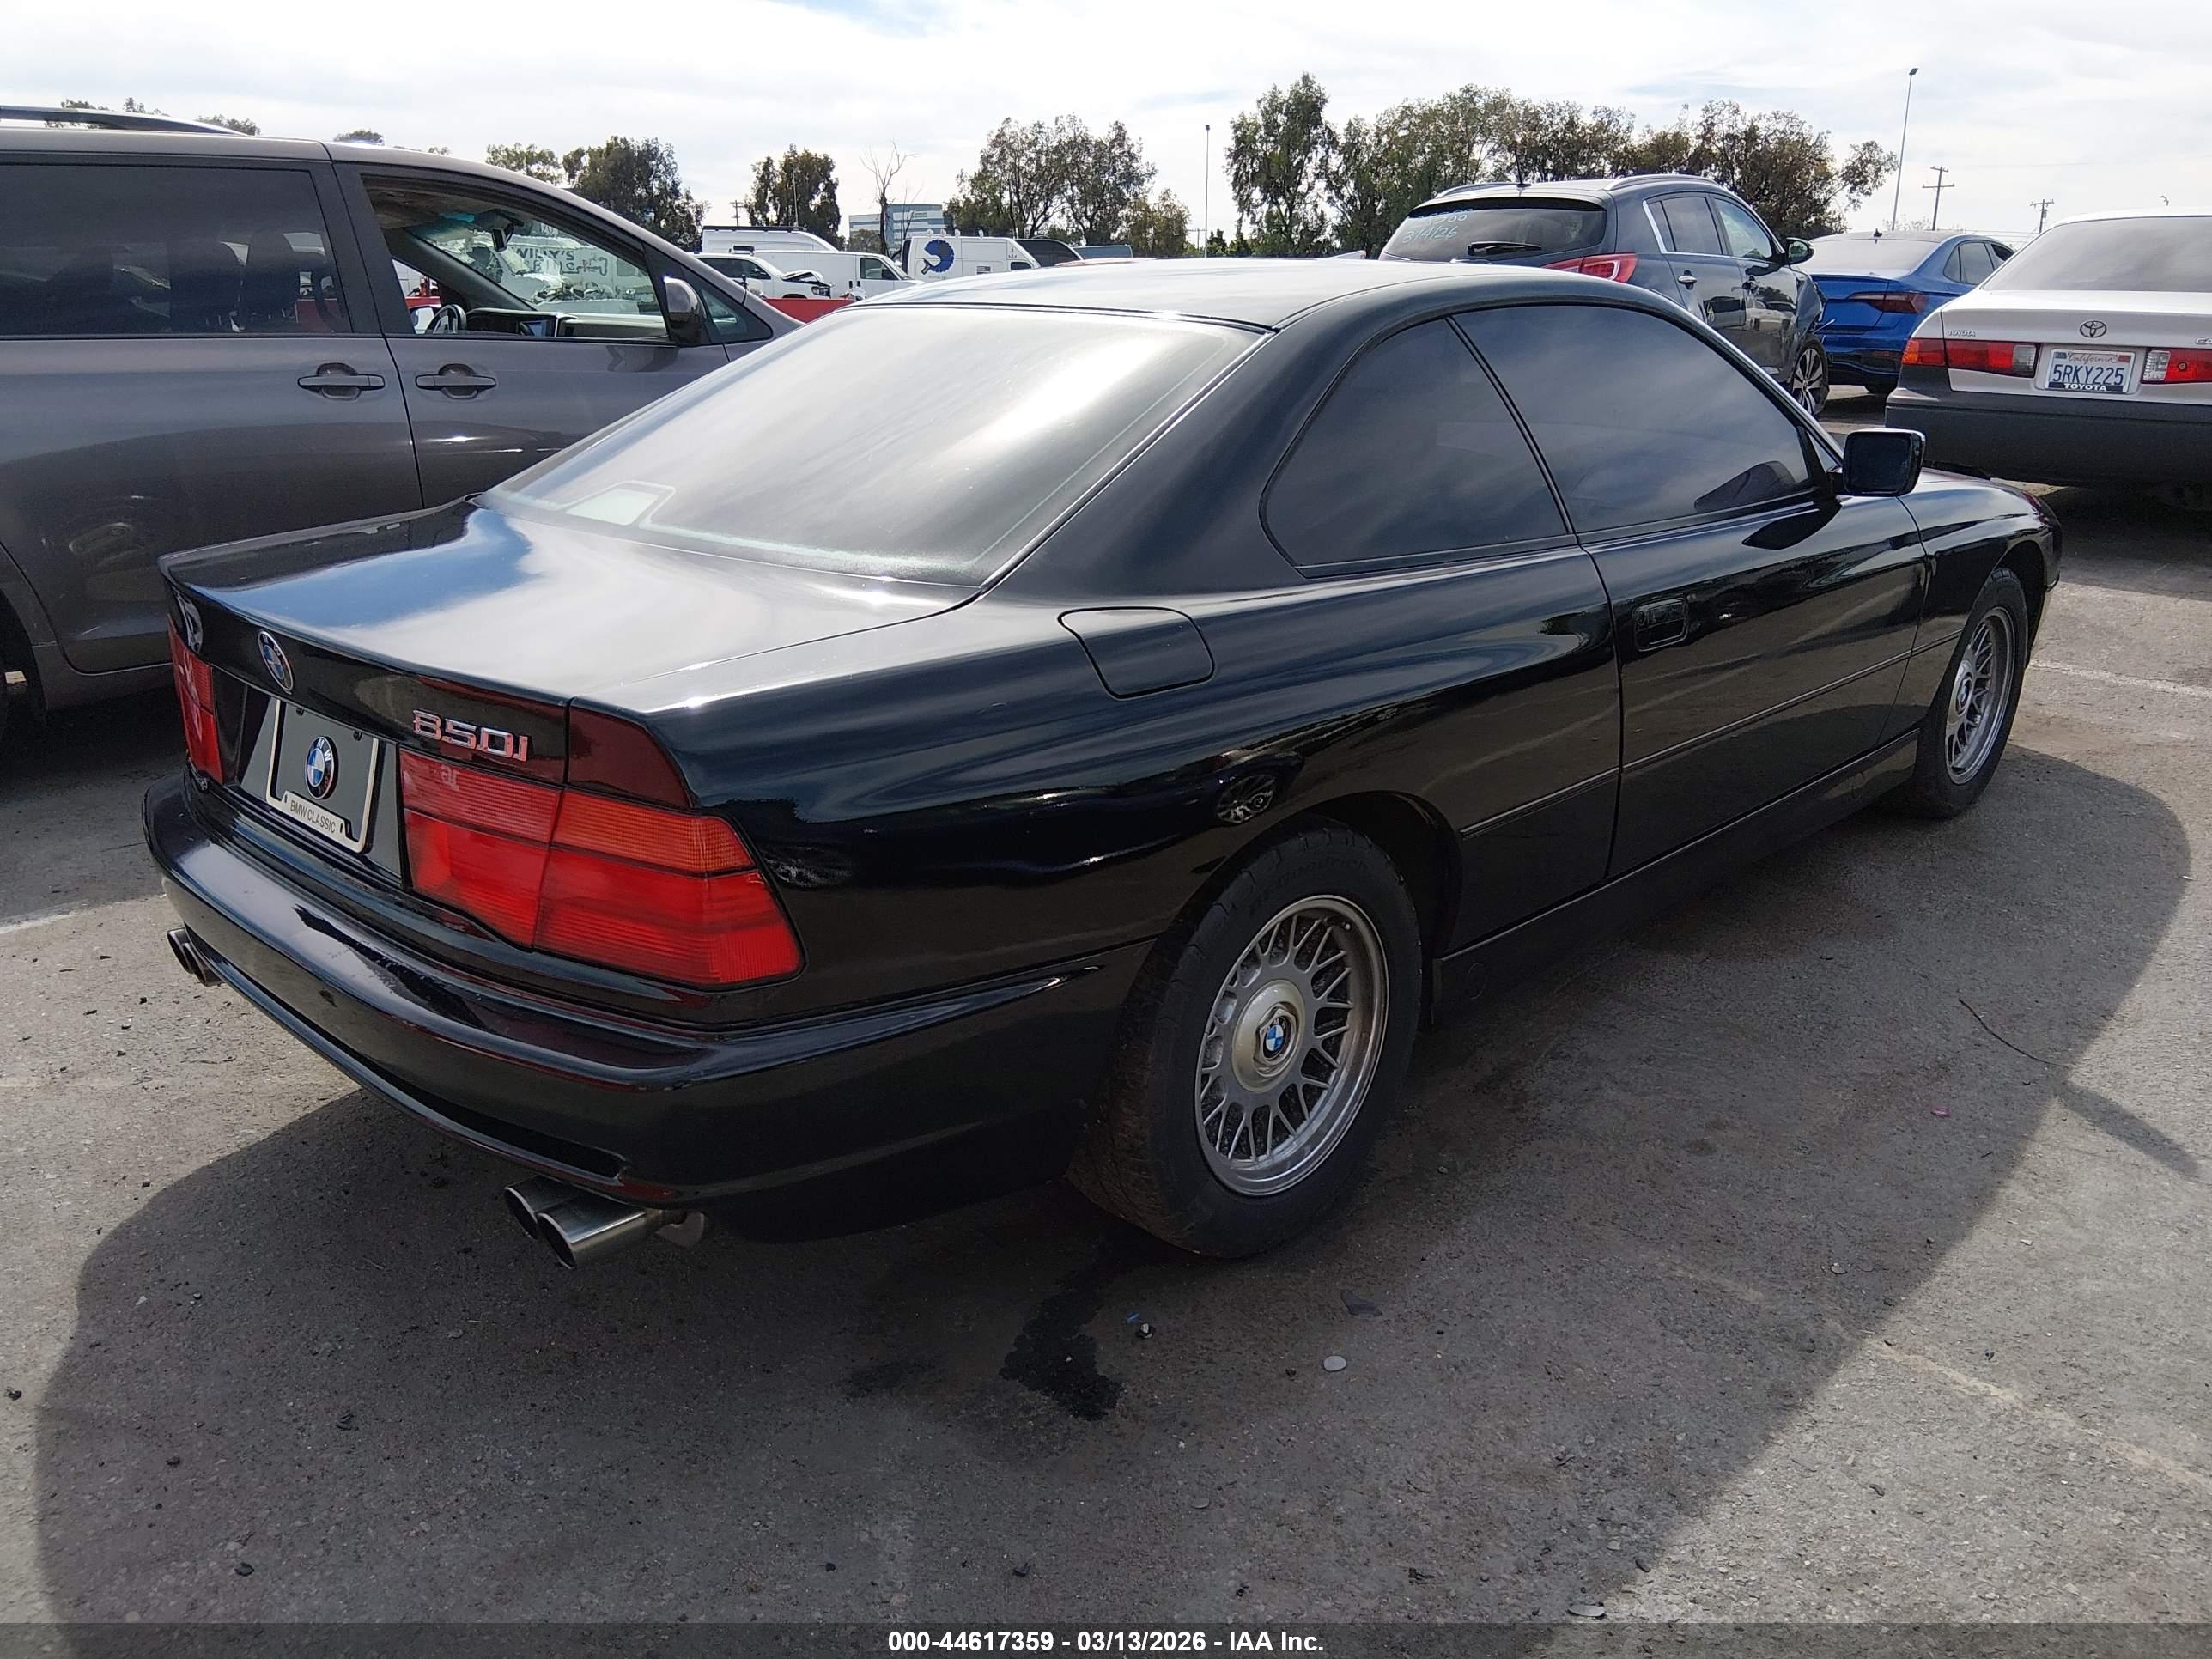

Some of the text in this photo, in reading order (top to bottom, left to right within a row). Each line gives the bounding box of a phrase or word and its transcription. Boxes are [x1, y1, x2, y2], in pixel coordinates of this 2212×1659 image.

[1947, 329, 1977, 337] TOYOTA
[2052, 364, 2124, 386] 5RKY225
[2063, 383, 2107, 392] TOYOTA
[290, 799, 337, 834] BMW CLASSIC
